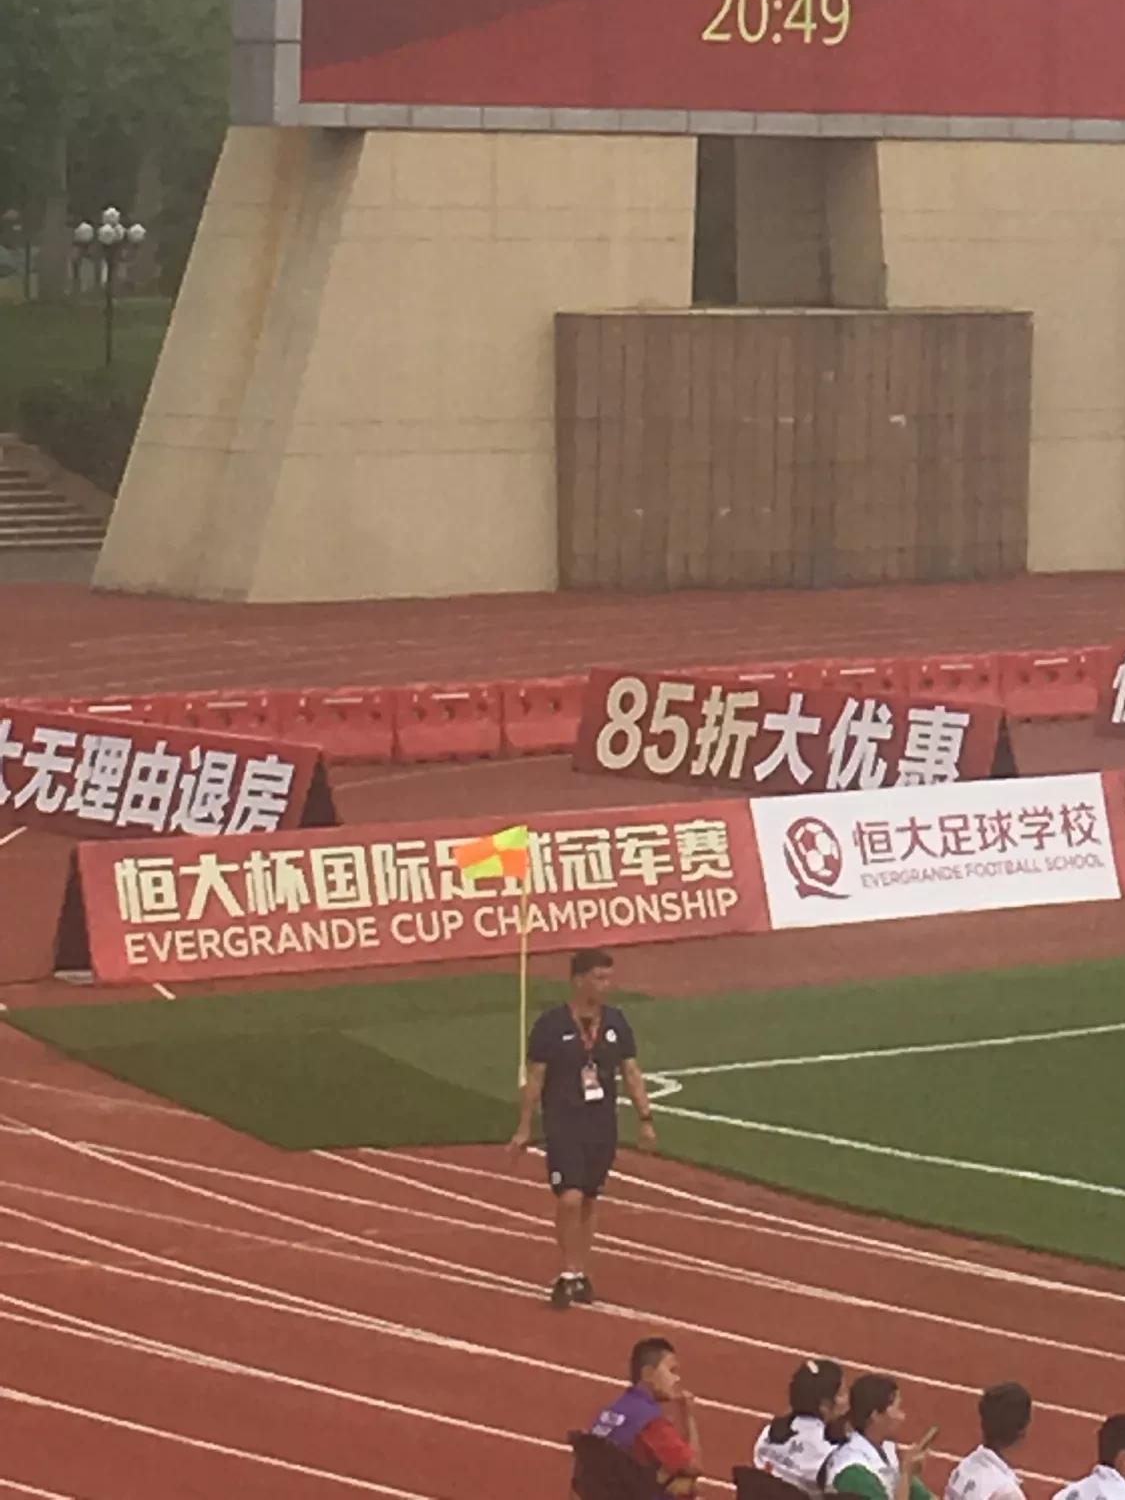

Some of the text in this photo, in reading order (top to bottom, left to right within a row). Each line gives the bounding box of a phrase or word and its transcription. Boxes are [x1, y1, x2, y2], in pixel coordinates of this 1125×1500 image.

[596, 676, 970, 791] 85折大优惠
[853, 801, 1102, 865] 恒大足球学校
[860, 852, 1105, 889] EVERGRANDE FOOTBALL SCHOOL
[125, 887, 739, 965] EVERGRANDE CUP CHAMPIONSHIP
